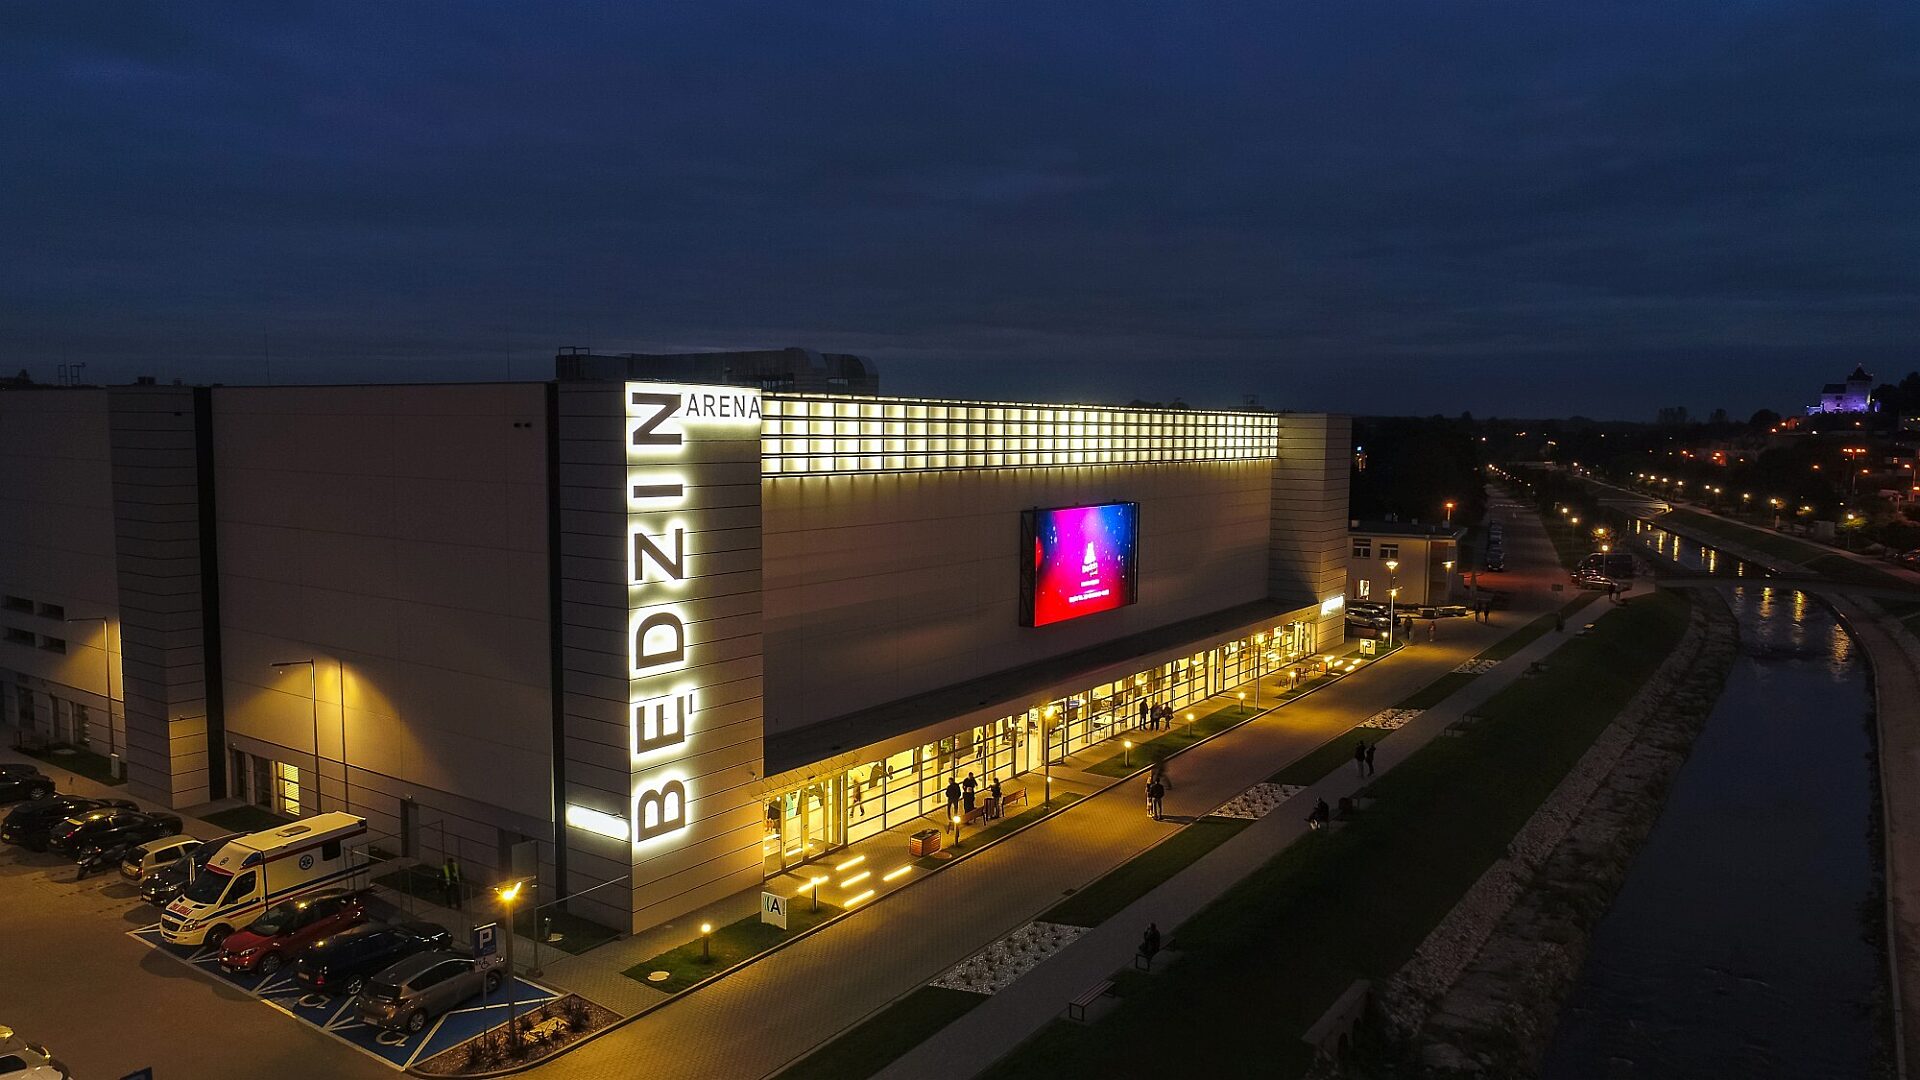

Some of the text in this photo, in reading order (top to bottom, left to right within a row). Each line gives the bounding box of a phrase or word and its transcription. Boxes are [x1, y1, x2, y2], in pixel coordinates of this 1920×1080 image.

[686, 394, 762, 419] ARENA
[632, 392, 693, 843] BĘDZIN
[479, 928, 493, 950] P
